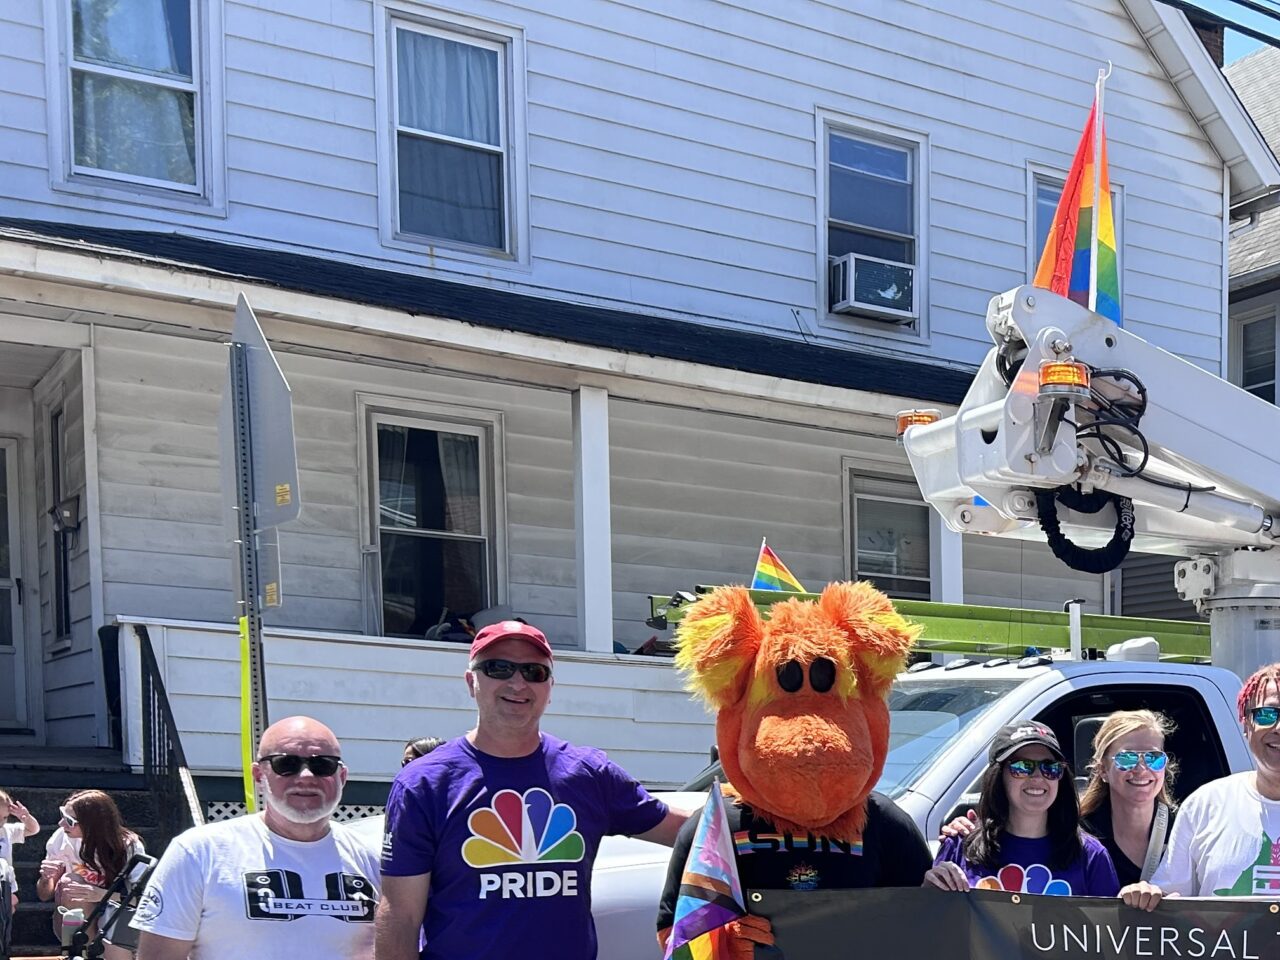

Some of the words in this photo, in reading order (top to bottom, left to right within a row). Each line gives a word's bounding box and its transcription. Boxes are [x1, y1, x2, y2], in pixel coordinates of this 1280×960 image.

[479, 871, 578, 899] PRIDE
[273, 902, 313, 910] BEAT
[320, 904, 360, 912] CLUB
[1031, 922, 1260, 960] UNIVERSAL
